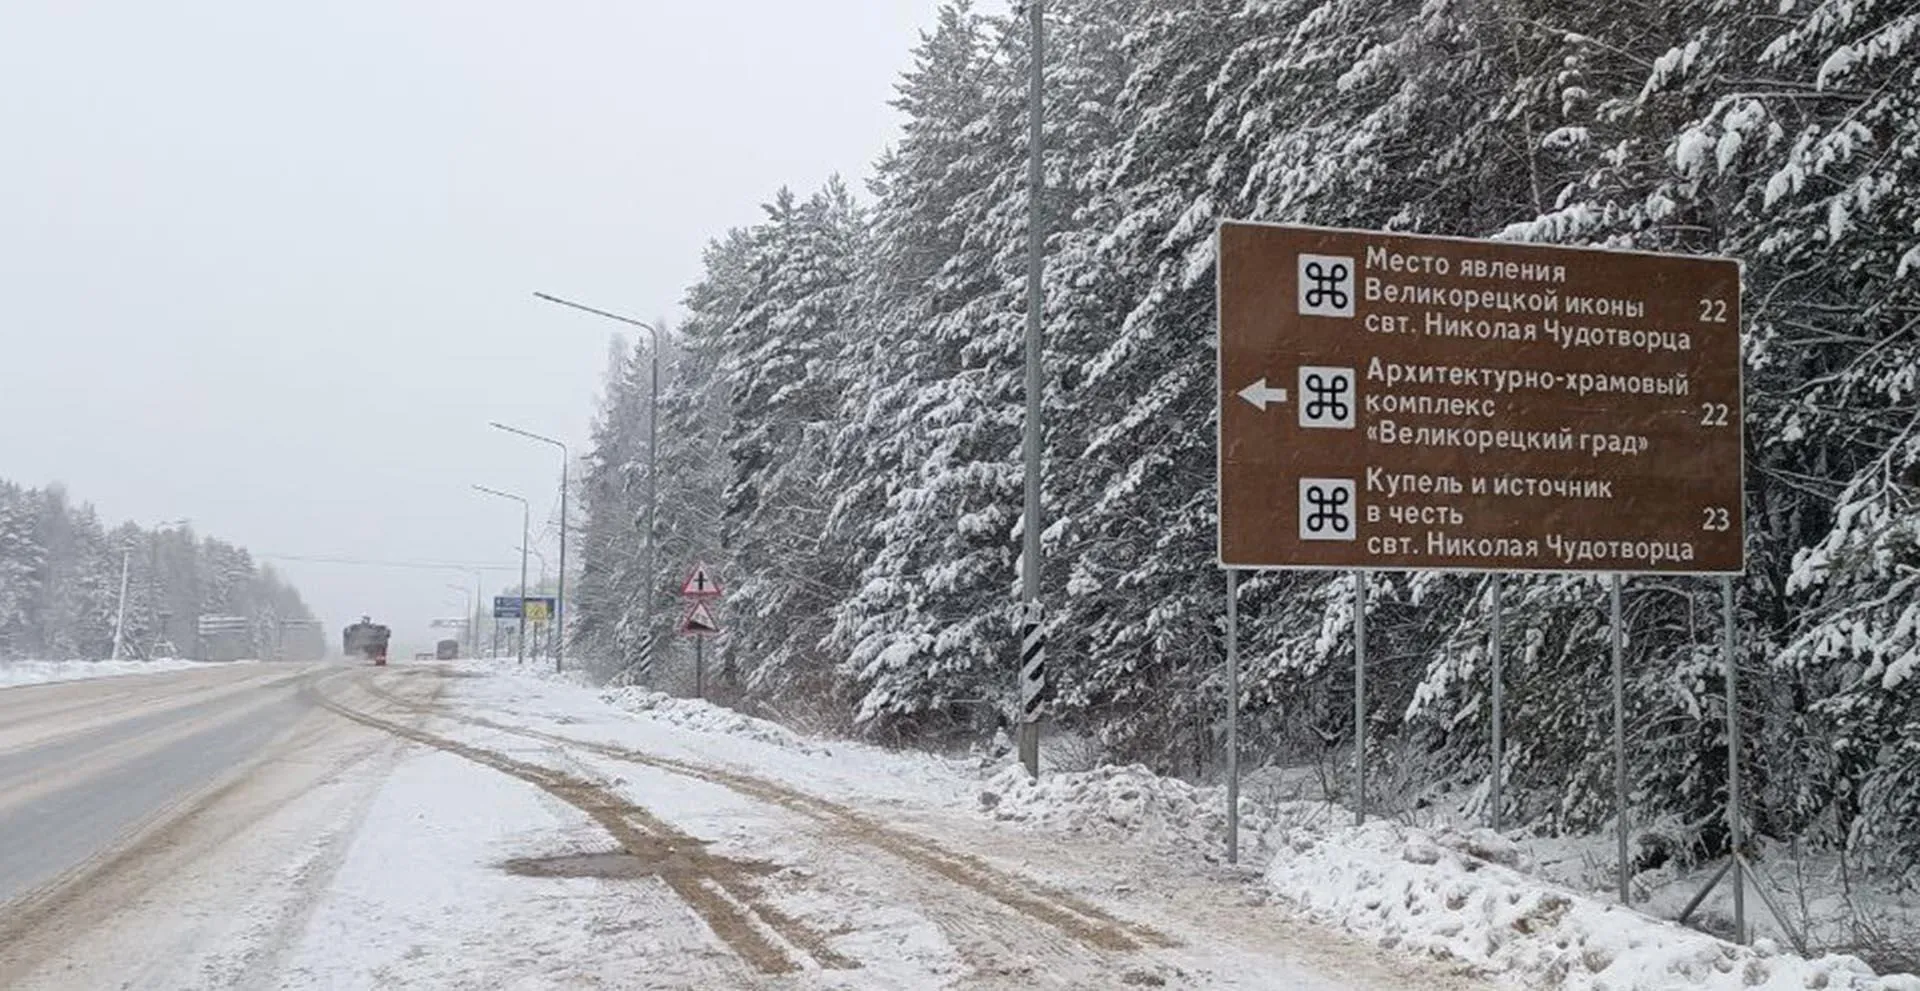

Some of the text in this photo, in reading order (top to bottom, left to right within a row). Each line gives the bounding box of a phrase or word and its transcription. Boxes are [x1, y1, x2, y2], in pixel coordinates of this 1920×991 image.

[1365, 245, 1566, 282] Место явления
[1365, 277, 1644, 318] Великорецкой иконы
[1700, 299, 1727, 323] 22
[1365, 311, 1691, 353] свт. Николая Чудотворца
[1367, 356, 1689, 396] Архитектурно-храмовый
[1365, 394, 1495, 418] комплекс
[1700, 402, 1728, 426] 22
[1366, 419, 1648, 457] «Великорецкий град»
[1367, 466, 1612, 498] Купель и источник
[1367, 505, 1464, 525] в честь
[1702, 507, 1730, 531] 23
[1367, 531, 1694, 565] свт. Николая Чудотворца
